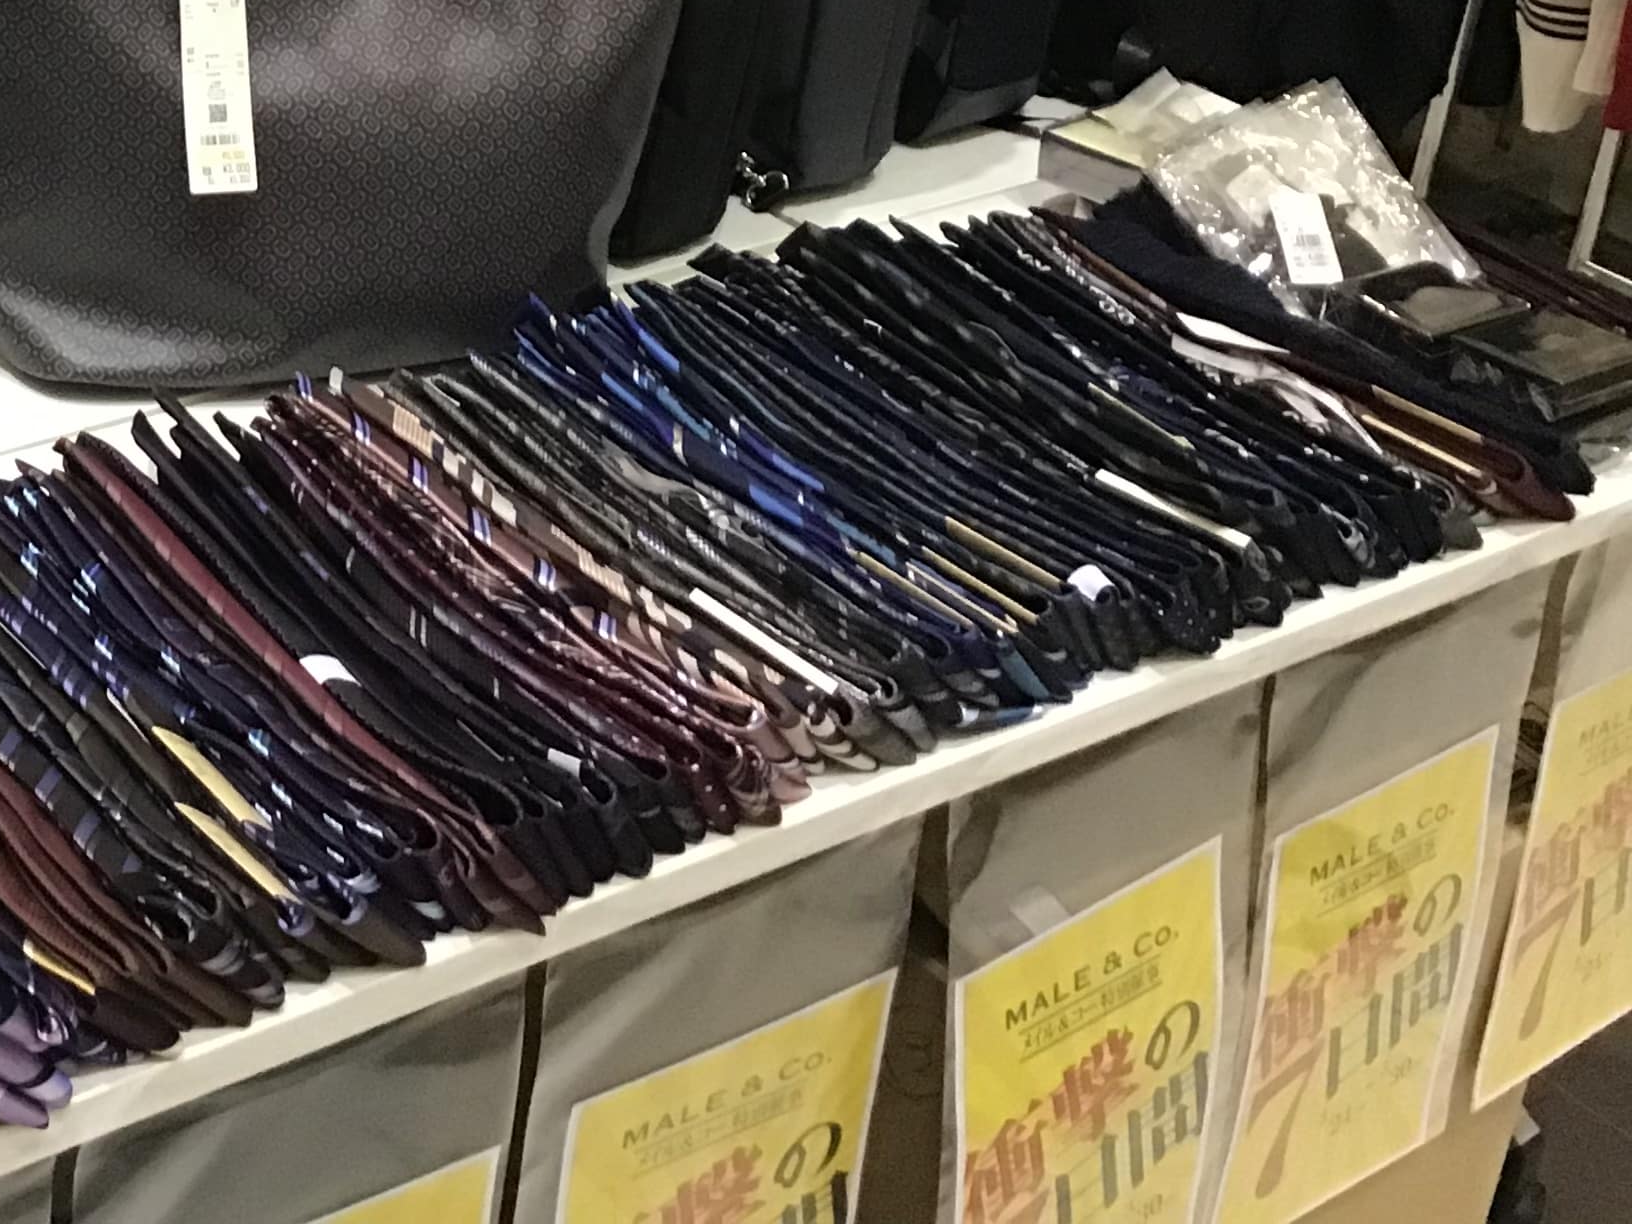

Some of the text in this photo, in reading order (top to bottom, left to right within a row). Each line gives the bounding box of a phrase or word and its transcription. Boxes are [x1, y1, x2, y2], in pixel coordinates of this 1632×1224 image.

[1310, 834, 1382, 887] MALE
[1005, 925, 1180, 1030] MALE & CO.
[621, 1087, 728, 1151] MALE
